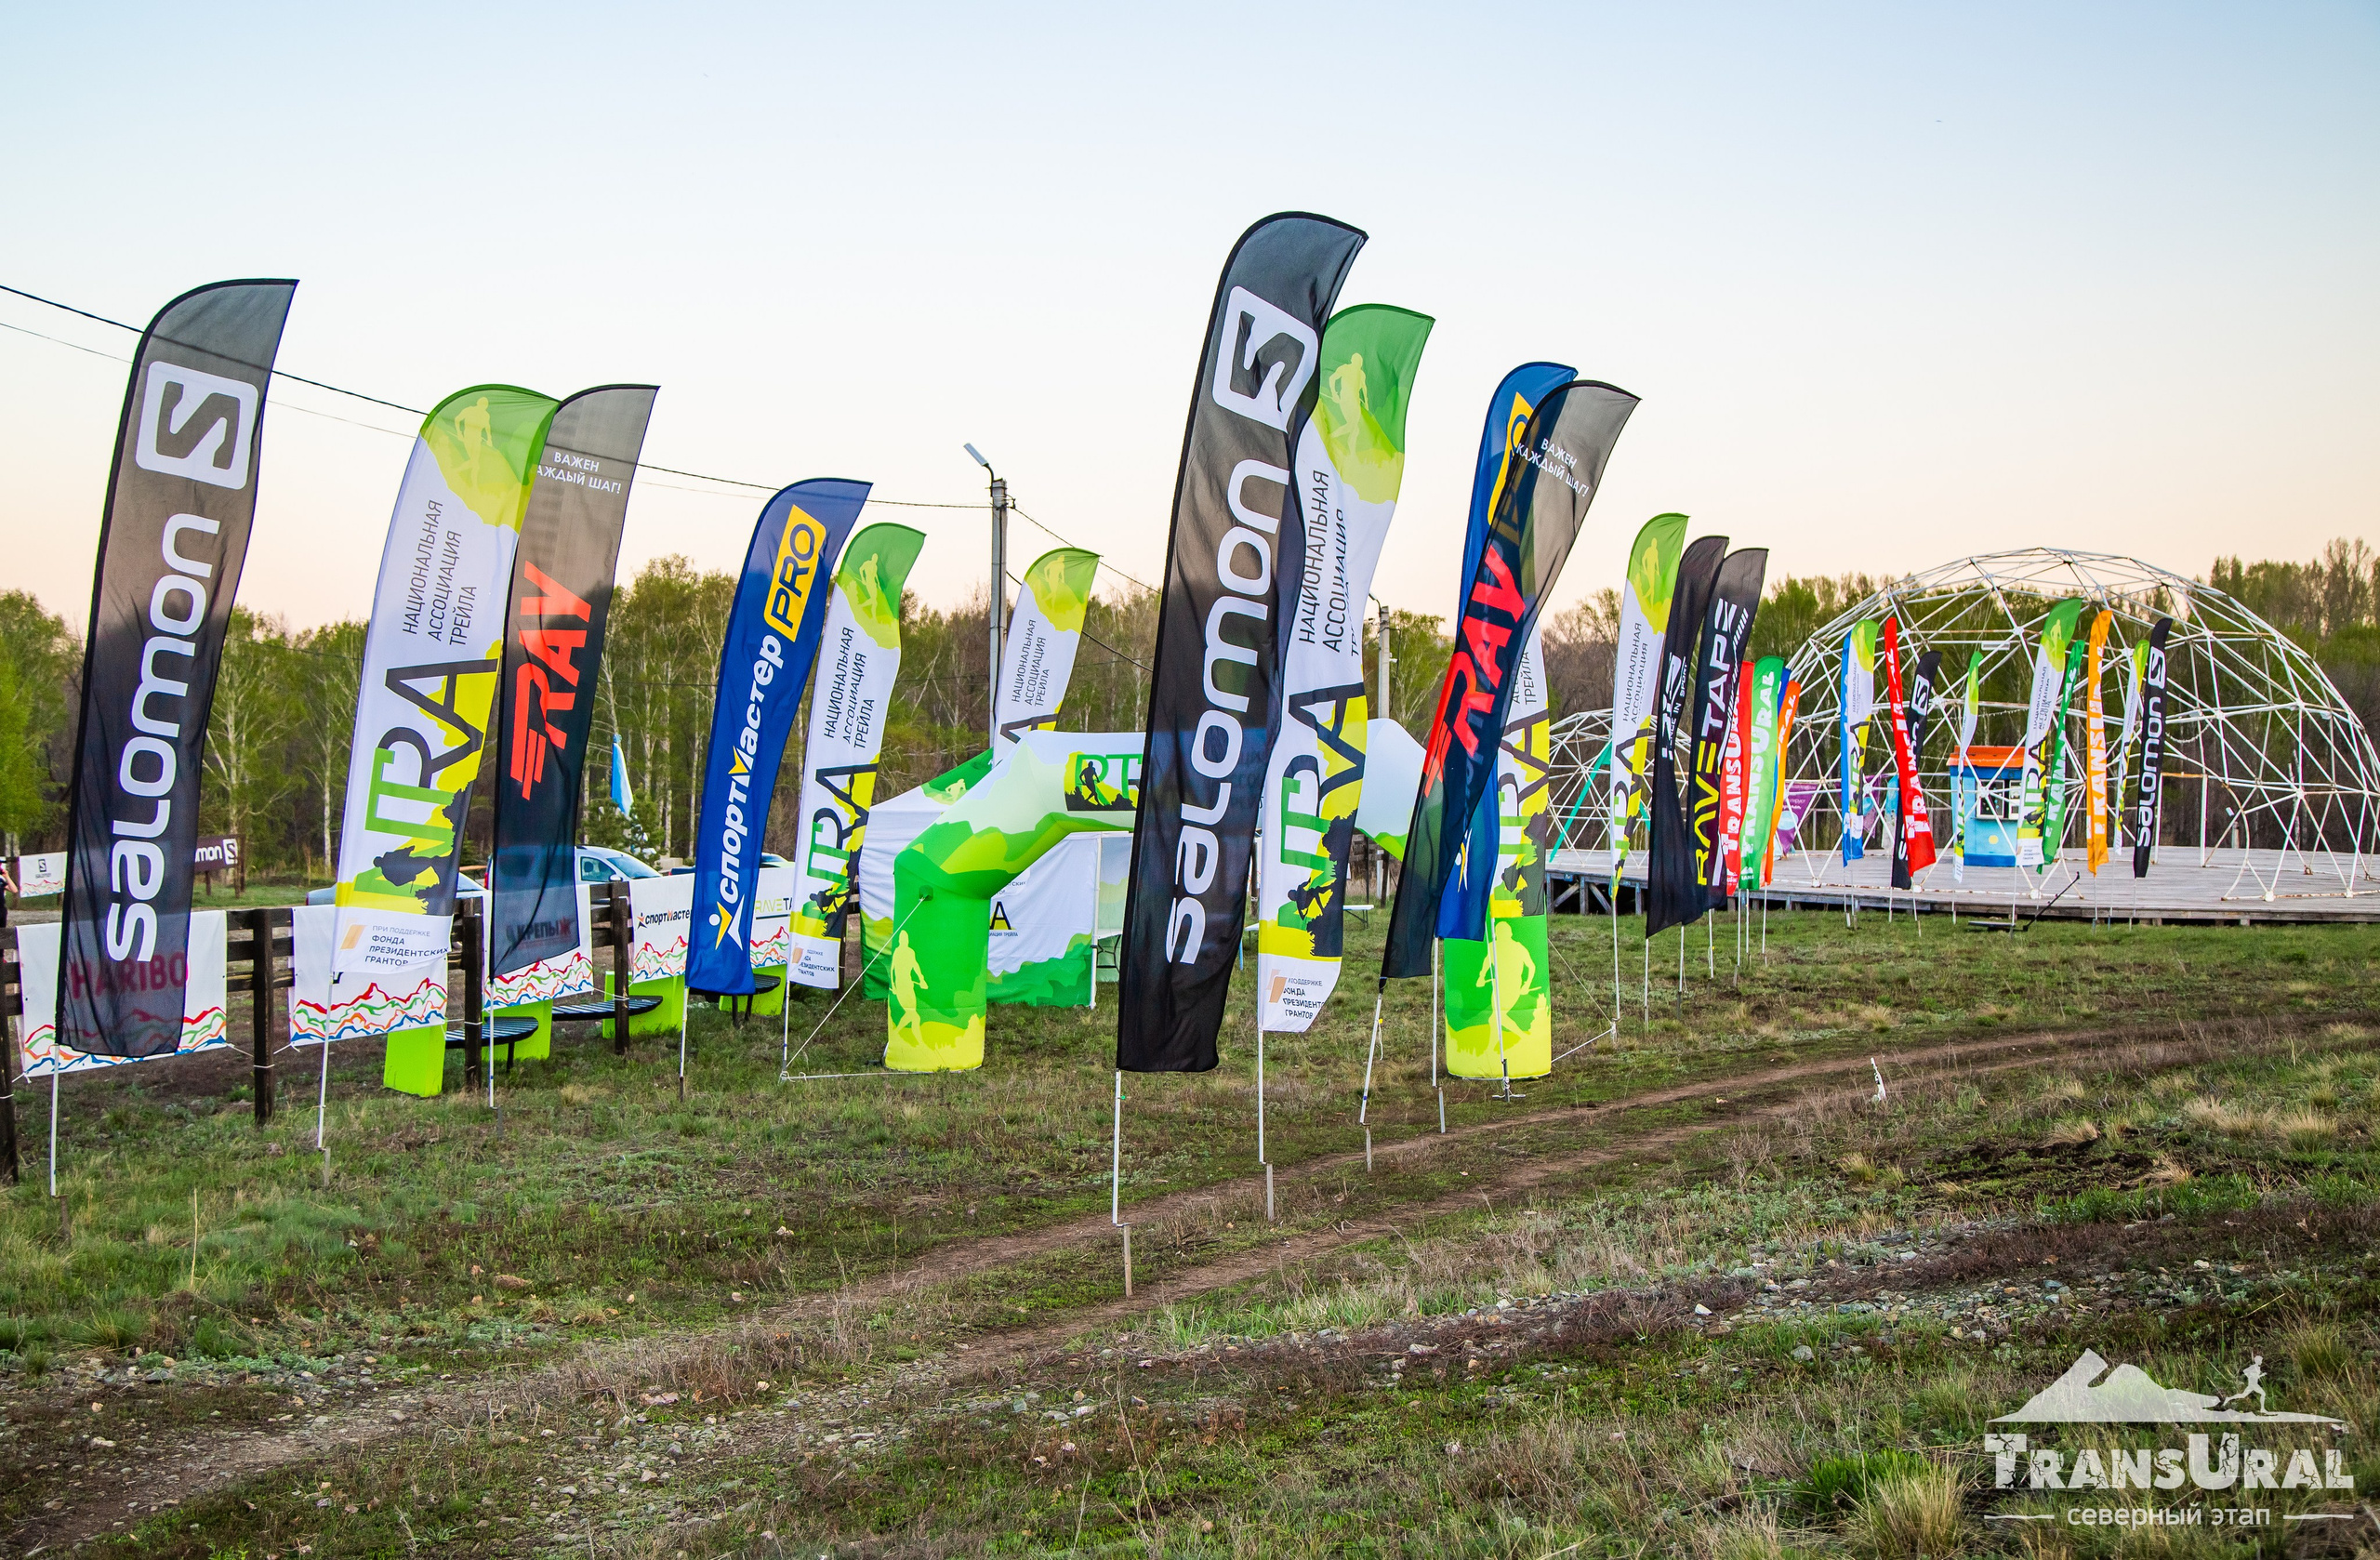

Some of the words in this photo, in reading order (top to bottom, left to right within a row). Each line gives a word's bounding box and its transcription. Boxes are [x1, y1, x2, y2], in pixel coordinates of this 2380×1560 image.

[536, 464, 586, 486] АЖДЫЙ
[588, 476, 622, 494] ШАГ!
[553, 452, 600, 472] ВАЖЕН
[1516, 443, 1565, 481] КАЖДЫЙ
[1565, 472, 1590, 497] ШАГ!
[1541, 438, 1578, 469] ВАЖЕН
[403, 499, 443, 635] НАЦИОНАЛЬНАЯ
[428, 530, 462, 641] АССОЦИАЦИЯ
[770, 522, 815, 630] PRO
[1298, 469, 1329, 644] НАЦИОНАЛЬНАЯ
[449, 586, 477, 646] ТРЕЙЛА
[509, 560, 592, 801] RAY
[824, 627, 854, 739] НАЦИОНАЛЬНАЯ
[1012, 618, 1037, 703] НАЦИОНАЛЬНАЯ
[1025, 636, 1047, 707] АССОЦИАЦИЯ
[1522, 652, 1537, 706] ТРЕЙЛА
[1622, 622, 1642, 722] НАЦИОНАЛЬНАЯ
[1631, 642, 1648, 724] АССОЦИАЦИЯ
[842, 652, 866, 745] АССОЦИАЦИЯ
[853, 699, 875, 748] ТРЕЙЛА
[1166, 459, 1290, 966] salomon
[1673, 702, 1682, 714] IN
[106, 513, 221, 962] salomon
[1694, 598, 1738, 886] RAVETAPE
[2136, 696, 2162, 848] salomon
[372, 934, 404, 945] ФОНДА
[389, 927, 430, 937] ПОДДЕРЖКЕ
[755, 897, 792, 913] RAVET
[369, 945, 449, 957] ПРЕЗИДЕНТСКИХ
[1282, 998, 1325, 1009] ПРЕЗИДЕНТ
[1285, 1010, 1314, 1019] ГРАНТОВ
